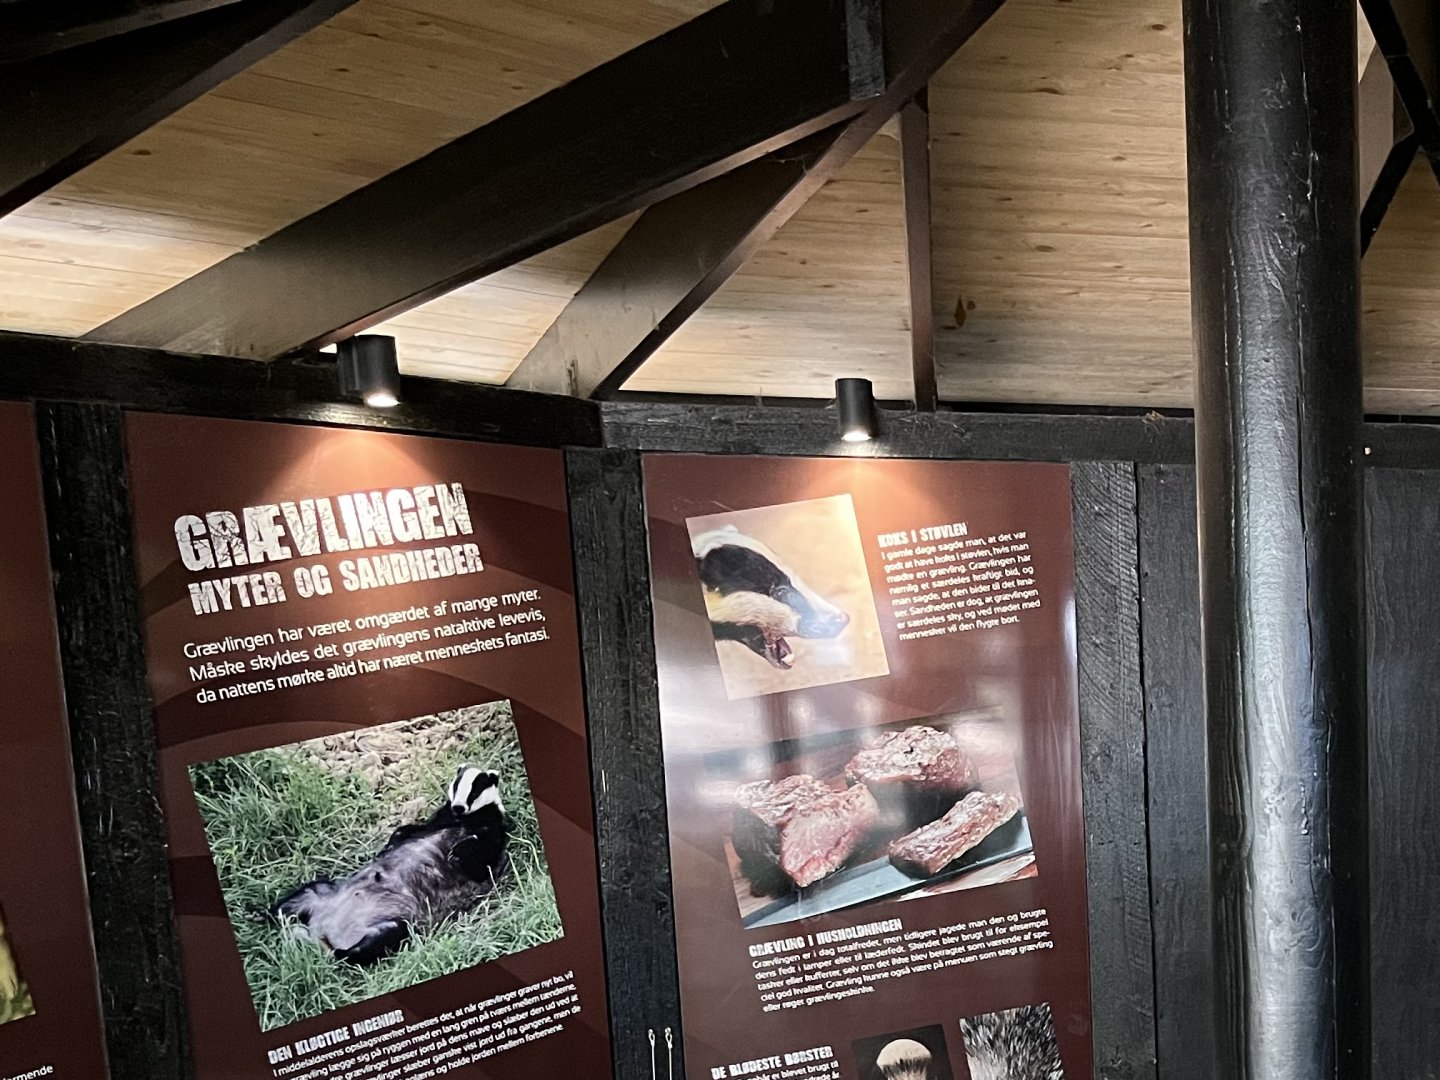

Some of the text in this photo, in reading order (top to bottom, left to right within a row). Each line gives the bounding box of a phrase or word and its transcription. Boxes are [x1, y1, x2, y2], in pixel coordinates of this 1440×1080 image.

[174, 482, 473, 571] GRÆVLINGEN
[877, 522, 967, 548] KOKS I STØVLEN
[188, 543, 484, 615] MYTER OG SANDHEDER
[968, 557, 1016, 570] Grævlingen
[184, 589, 541, 658] Grævlingen har været omgærdet af mange myter.
[189, 608, 545, 681] Måske skyldes det grævlingens nataktive levevis,
[196, 626, 550, 703] da nattens mørke altid har næret menneskets fantasi.
[749, 919, 902, 957] GRÆVLING I HUSHOLDNINGEN
[268, 1009, 404, 1064] DEN KLØGTIGE INGENIØR
[711, 1046, 833, 1080] DE BLØDESTE BØRSTER
